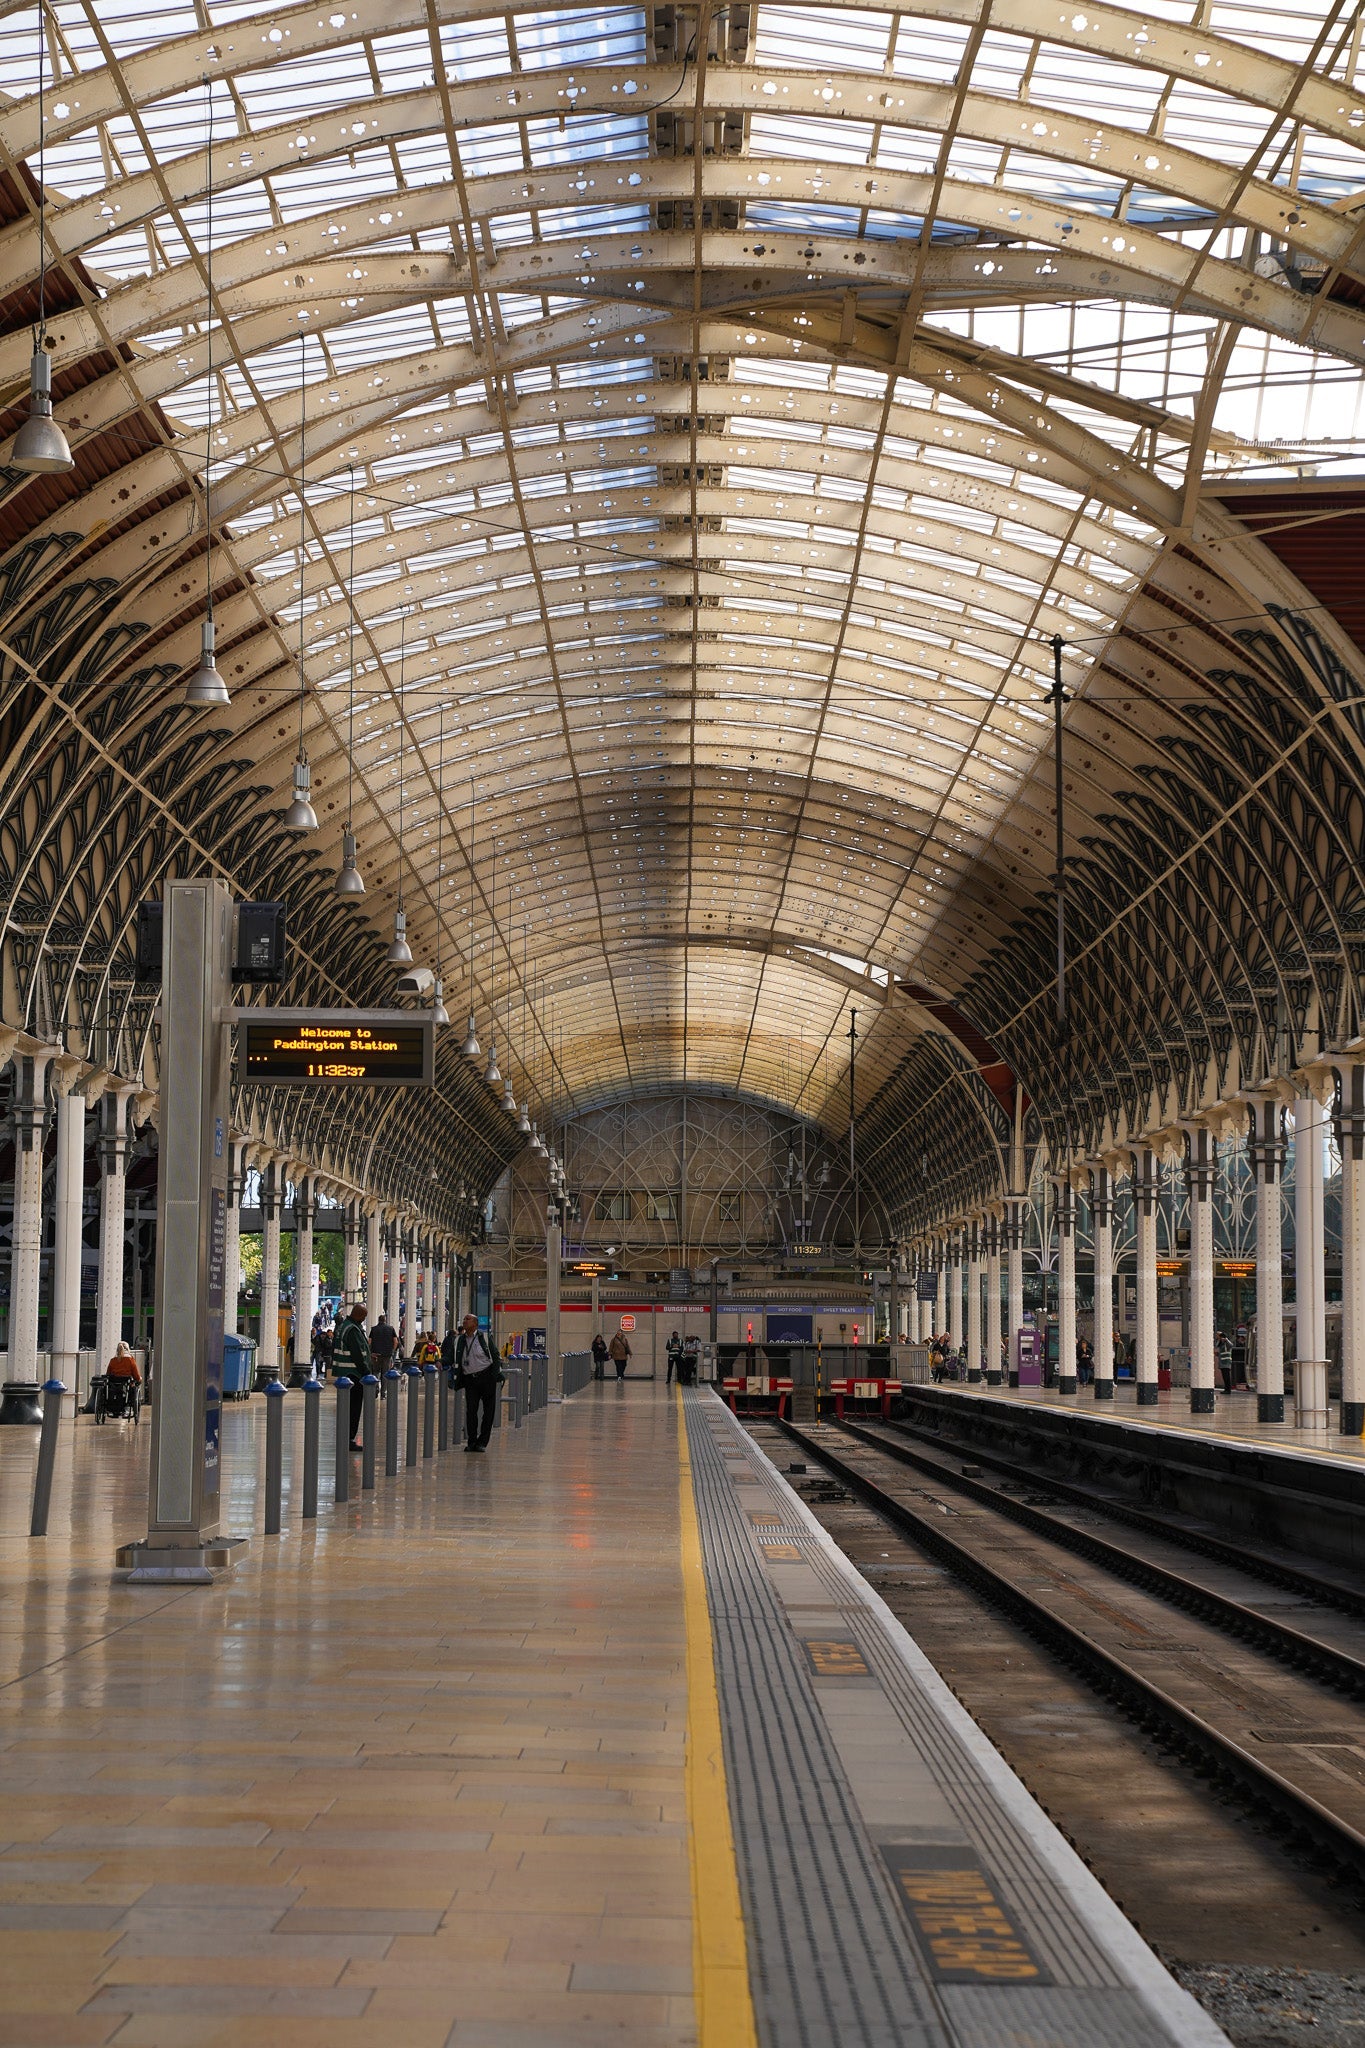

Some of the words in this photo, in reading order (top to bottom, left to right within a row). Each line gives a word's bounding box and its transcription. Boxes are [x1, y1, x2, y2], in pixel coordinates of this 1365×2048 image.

[300, 1027, 351, 1038] Welcome
[356, 1028, 372, 1038] to
[273, 1039, 345, 1052] Paddington
[349, 1040, 398, 1051] Station
[307, 1064, 366, 1077] 11:32:37
[897, 1869, 996, 1904] MIND
[913, 1905, 1014, 1936] THE
[929, 1936, 1039, 1978] GAP
